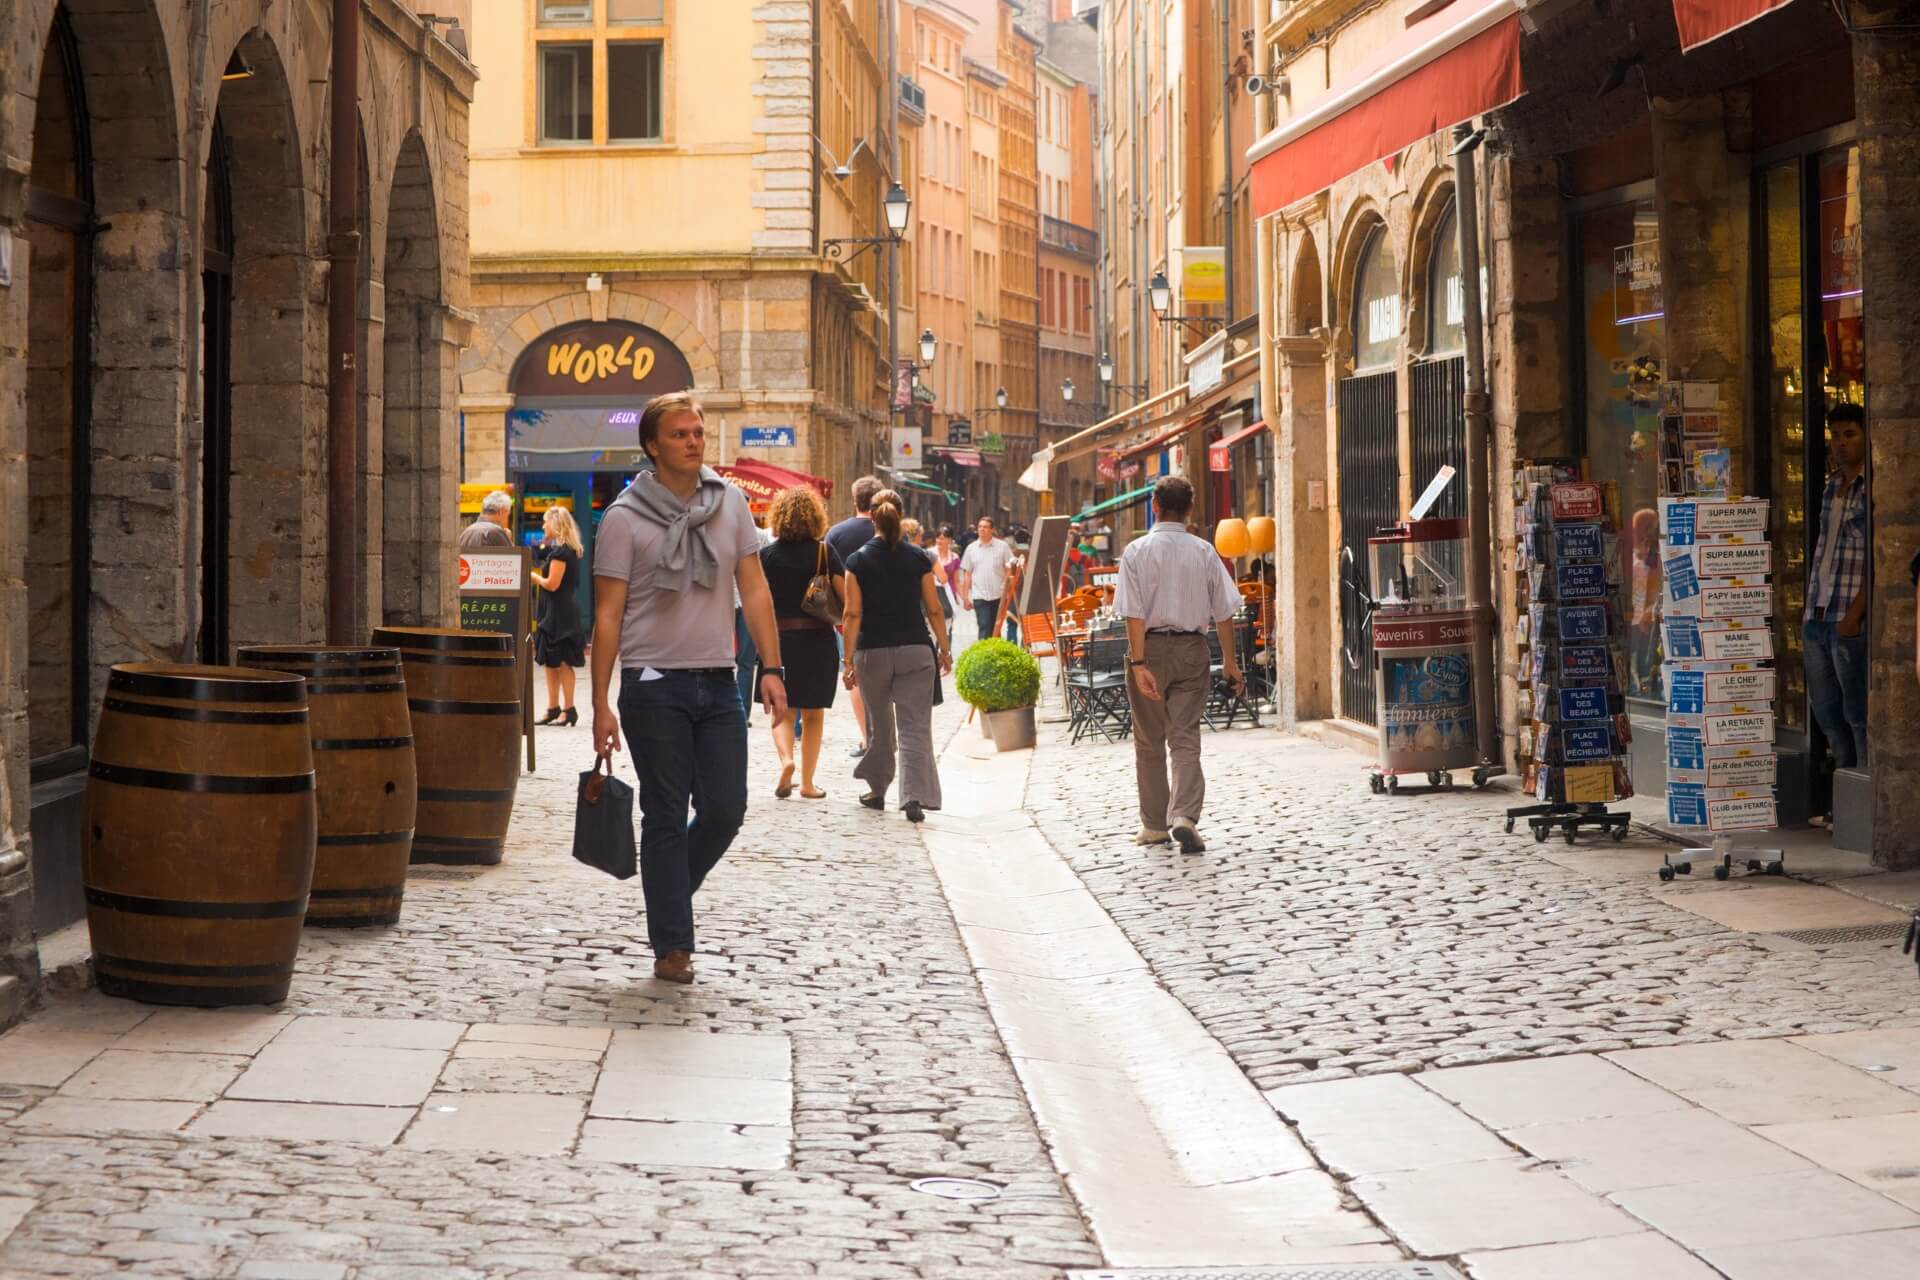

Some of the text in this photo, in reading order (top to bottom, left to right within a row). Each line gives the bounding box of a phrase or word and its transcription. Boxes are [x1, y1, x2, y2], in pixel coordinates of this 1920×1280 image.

[547, 335, 655, 384] WORLD
[608, 411, 638, 424] JEUX
[723, 471, 772, 496] Granitas
[1737, 507, 1757, 516] PAPA
[1563, 547, 1594, 556] SIESTE
[1706, 550, 1734, 560] SUPER
[472, 559, 513, 568] Partagez
[1567, 567, 1594, 576] PLACE
[484, 576, 513, 585] Plaisir
[1566, 609, 1598, 618] AVENUE
[1375, 626, 1425, 641] Souvenirs
[1725, 633, 1751, 641] MAMIE
[1572, 649, 1595, 657] PLACE
[1725, 675, 1757, 685] LE CHEF
[1569, 690, 1596, 699] PLACE
[1575, 700, 1592, 708] DES
[1569, 708, 1600, 717] BEAUFS
[1728, 717, 1765, 727] RETRAITE
[1572, 731, 1599, 740] PLACE
